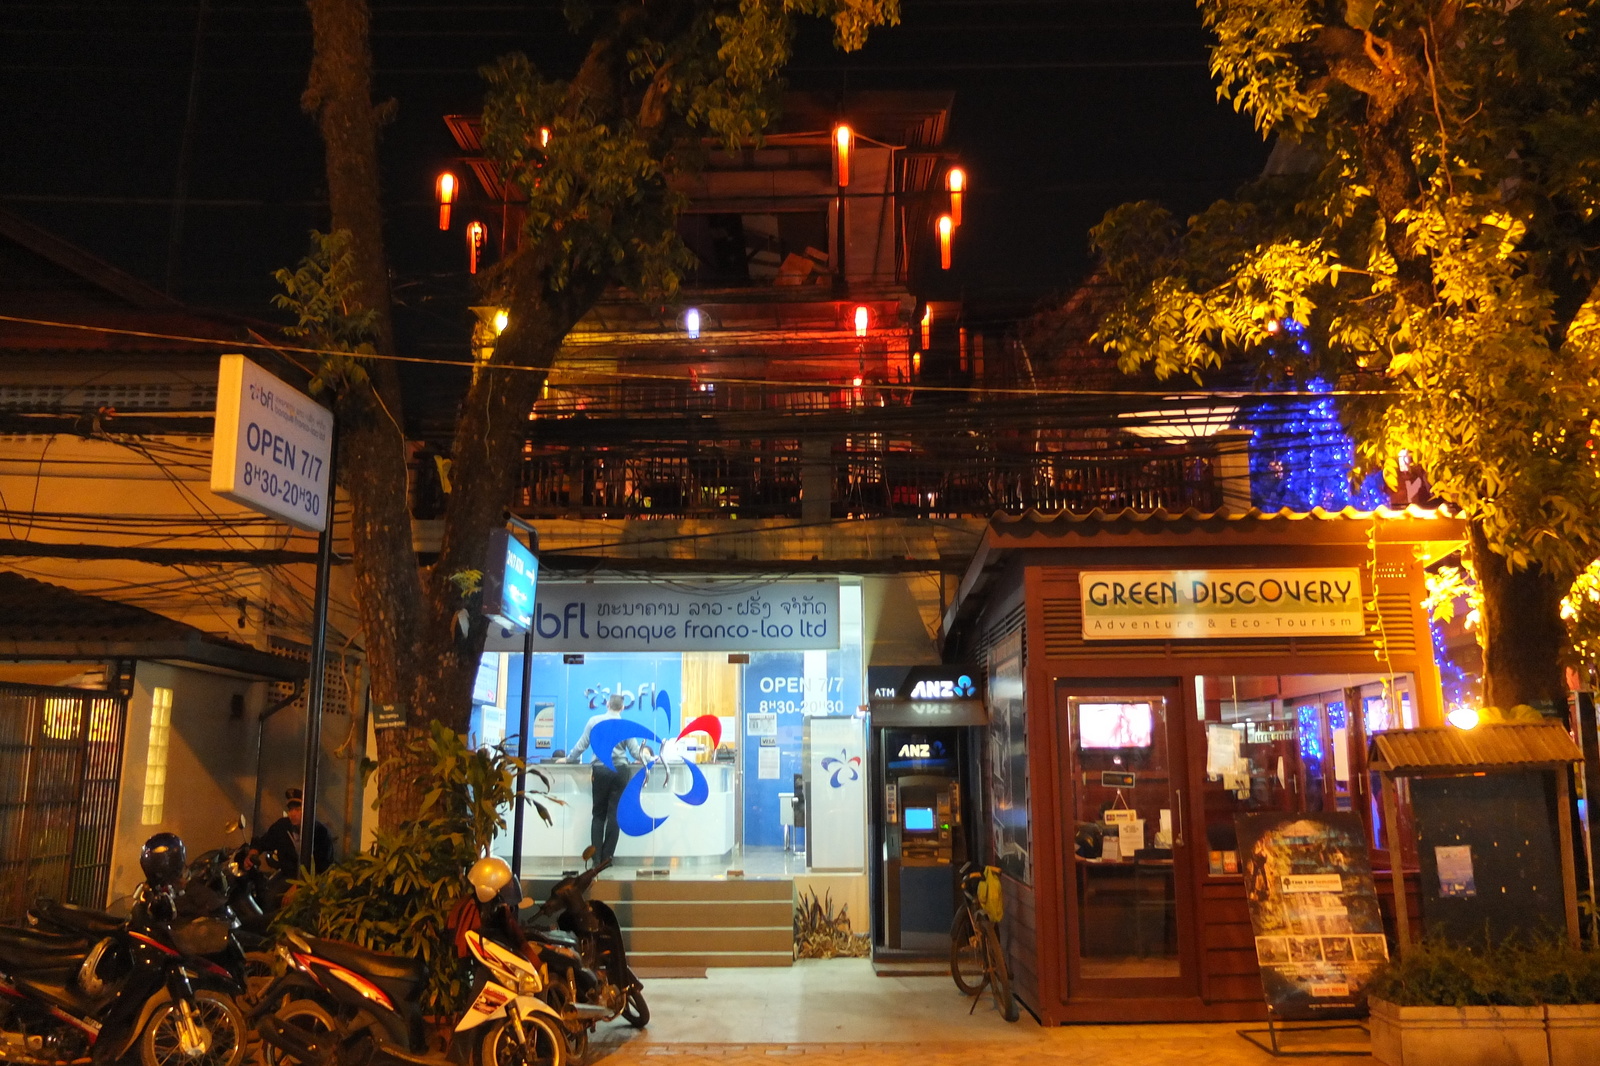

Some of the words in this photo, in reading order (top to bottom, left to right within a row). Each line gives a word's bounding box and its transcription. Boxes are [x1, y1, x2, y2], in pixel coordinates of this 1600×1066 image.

[247, 422, 296, 471] OPEN
[301, 450, 322, 482] 7/7
[1088, 580, 1178, 607] GREEN
[1191, 578, 1352, 606] DISCOVERY
[536, 602, 588, 639] bfl
[1094, 617, 1195, 630] Adventure
[1207, 618, 1217, 629] &
[1230, 615, 1353, 629] Eco-Tourism
[597, 621, 677, 644] banque
[684, 619, 793, 639] franco-lao
[799, 619, 828, 638] ltd
[759, 676, 812, 693] OPEN
[818, 676, 845, 693] 7/7
[874, 687, 895, 698] ATM
[910, 681, 955, 699] ANZ
[898, 743, 931, 758] ANZ
